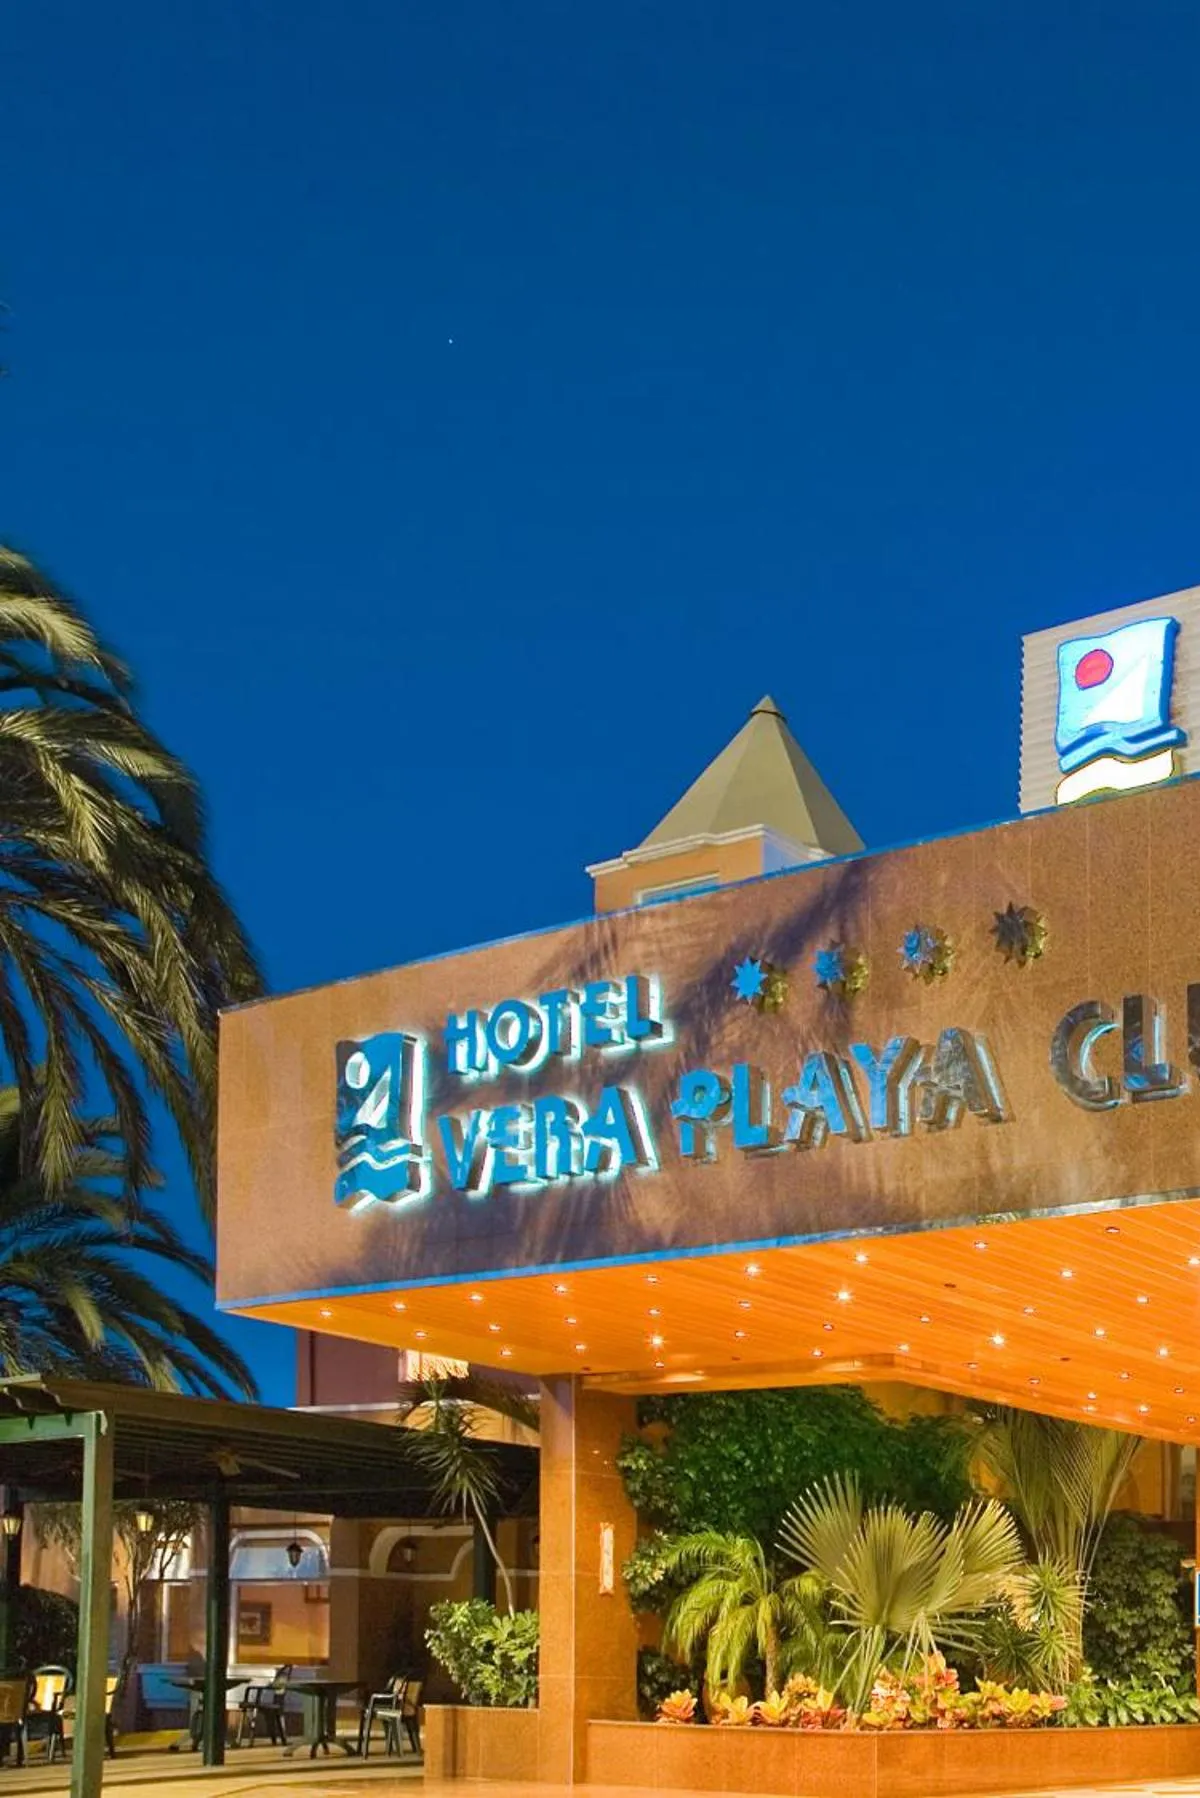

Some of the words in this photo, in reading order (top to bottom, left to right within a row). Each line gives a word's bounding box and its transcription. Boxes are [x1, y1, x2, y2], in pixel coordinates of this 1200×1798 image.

[443, 974, 668, 1076] HOTEL
[436, 1084, 658, 1194] VERA
[671, 1027, 1012, 1160] PLAYA
